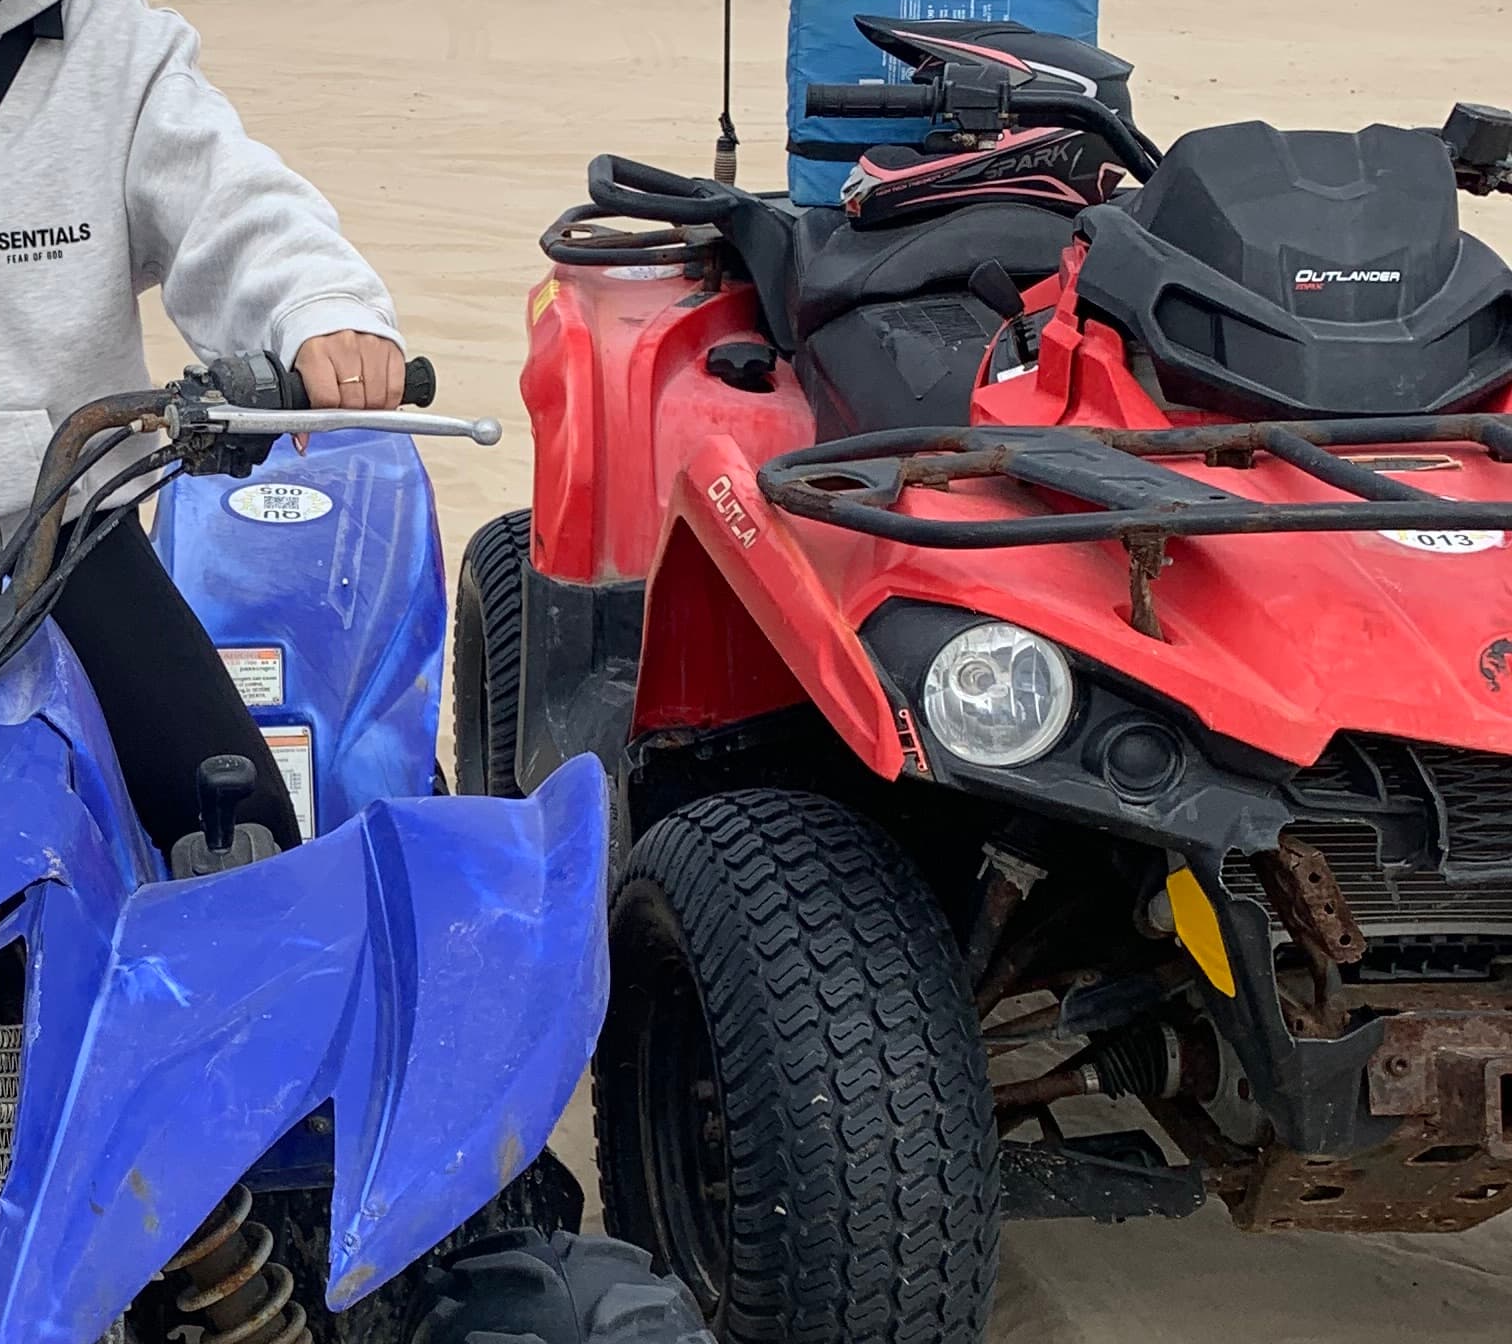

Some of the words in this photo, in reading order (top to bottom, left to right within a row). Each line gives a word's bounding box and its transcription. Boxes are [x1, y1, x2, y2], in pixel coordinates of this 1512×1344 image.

[984, 141, 1072, 180] SPARK
[6, 254, 29, 264] FEAR
[32, 252, 43, 261] OF
[46, 250, 63, 260] GOD
[1295, 269, 1401, 283] OUTLANDER
[259, 487, 303, 496] 005
[263, 510, 301, 520] QU
[1416, 534, 1475, 547] 013
